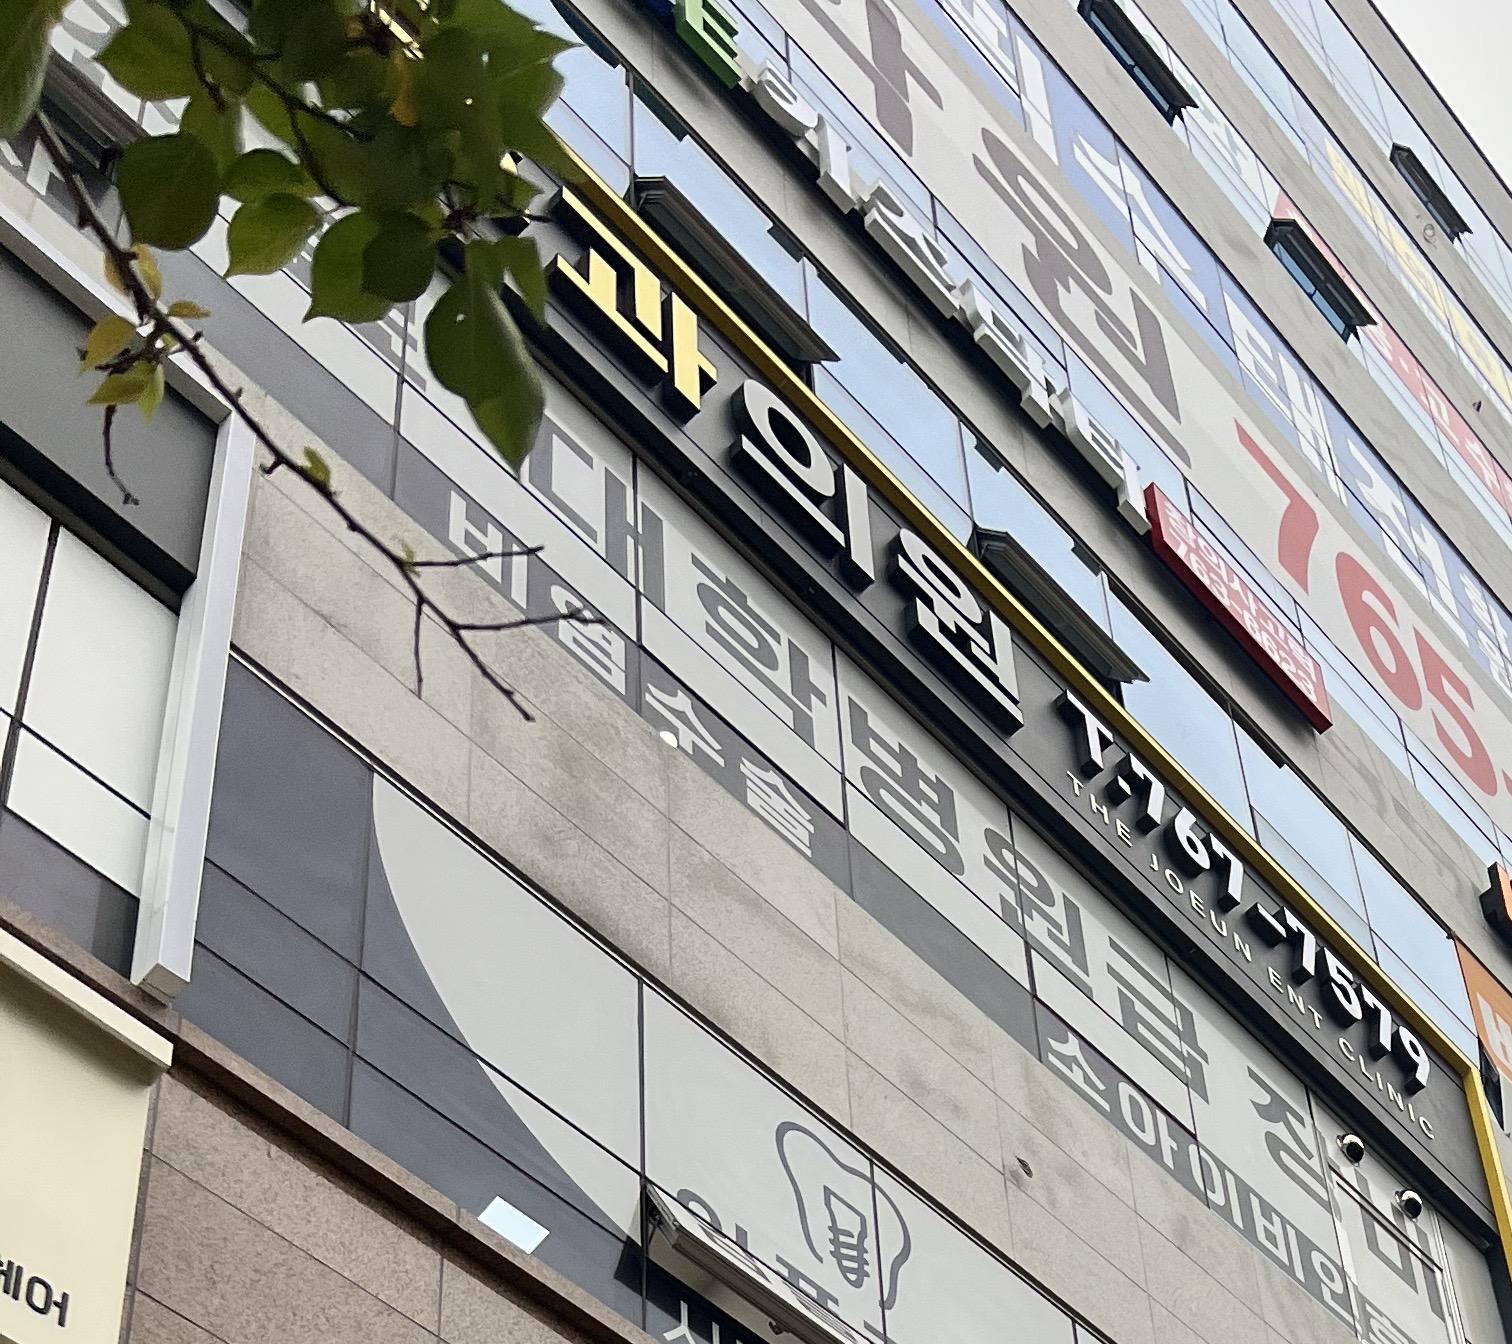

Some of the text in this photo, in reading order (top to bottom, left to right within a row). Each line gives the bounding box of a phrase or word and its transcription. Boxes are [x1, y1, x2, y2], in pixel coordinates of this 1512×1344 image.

[447, 488, 816, 858] 비염수술
[527, 408, 1446, 1325] 대학병원급 장비
[1067, 771, 1437, 1141] THE JOEUN ENT CLINIC
